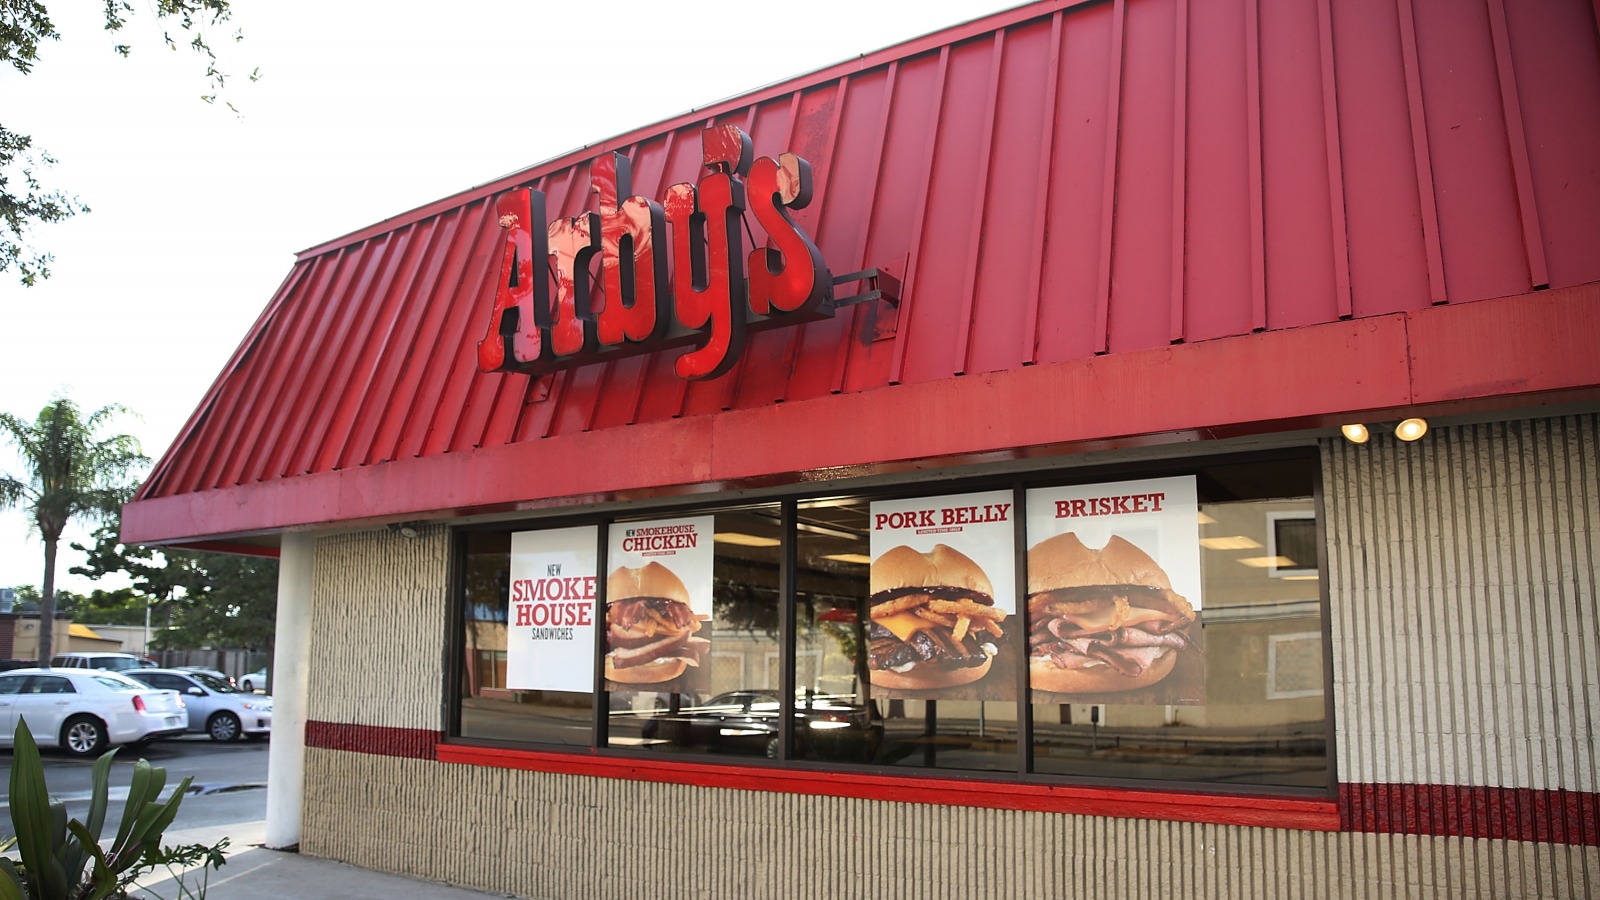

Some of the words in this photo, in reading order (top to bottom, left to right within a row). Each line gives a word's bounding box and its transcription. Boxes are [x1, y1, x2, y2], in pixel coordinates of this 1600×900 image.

[477, 124, 820, 381] Arby's
[875, 509, 936, 530] PORK
[941, 503, 1011, 526] BELLY
[1054, 492, 1165, 518] BRISKET
[622, 532, 698, 552] CHICKEN
[625, 529, 635, 537] NEW
[636, 524, 695, 537] SMOKEHOUSE
[547, 563, 562, 577] NEW
[512, 576, 597, 602] SMOKE
[516, 602, 592, 627] HOUSE
[531, 627, 574, 641] SANDWICHES
